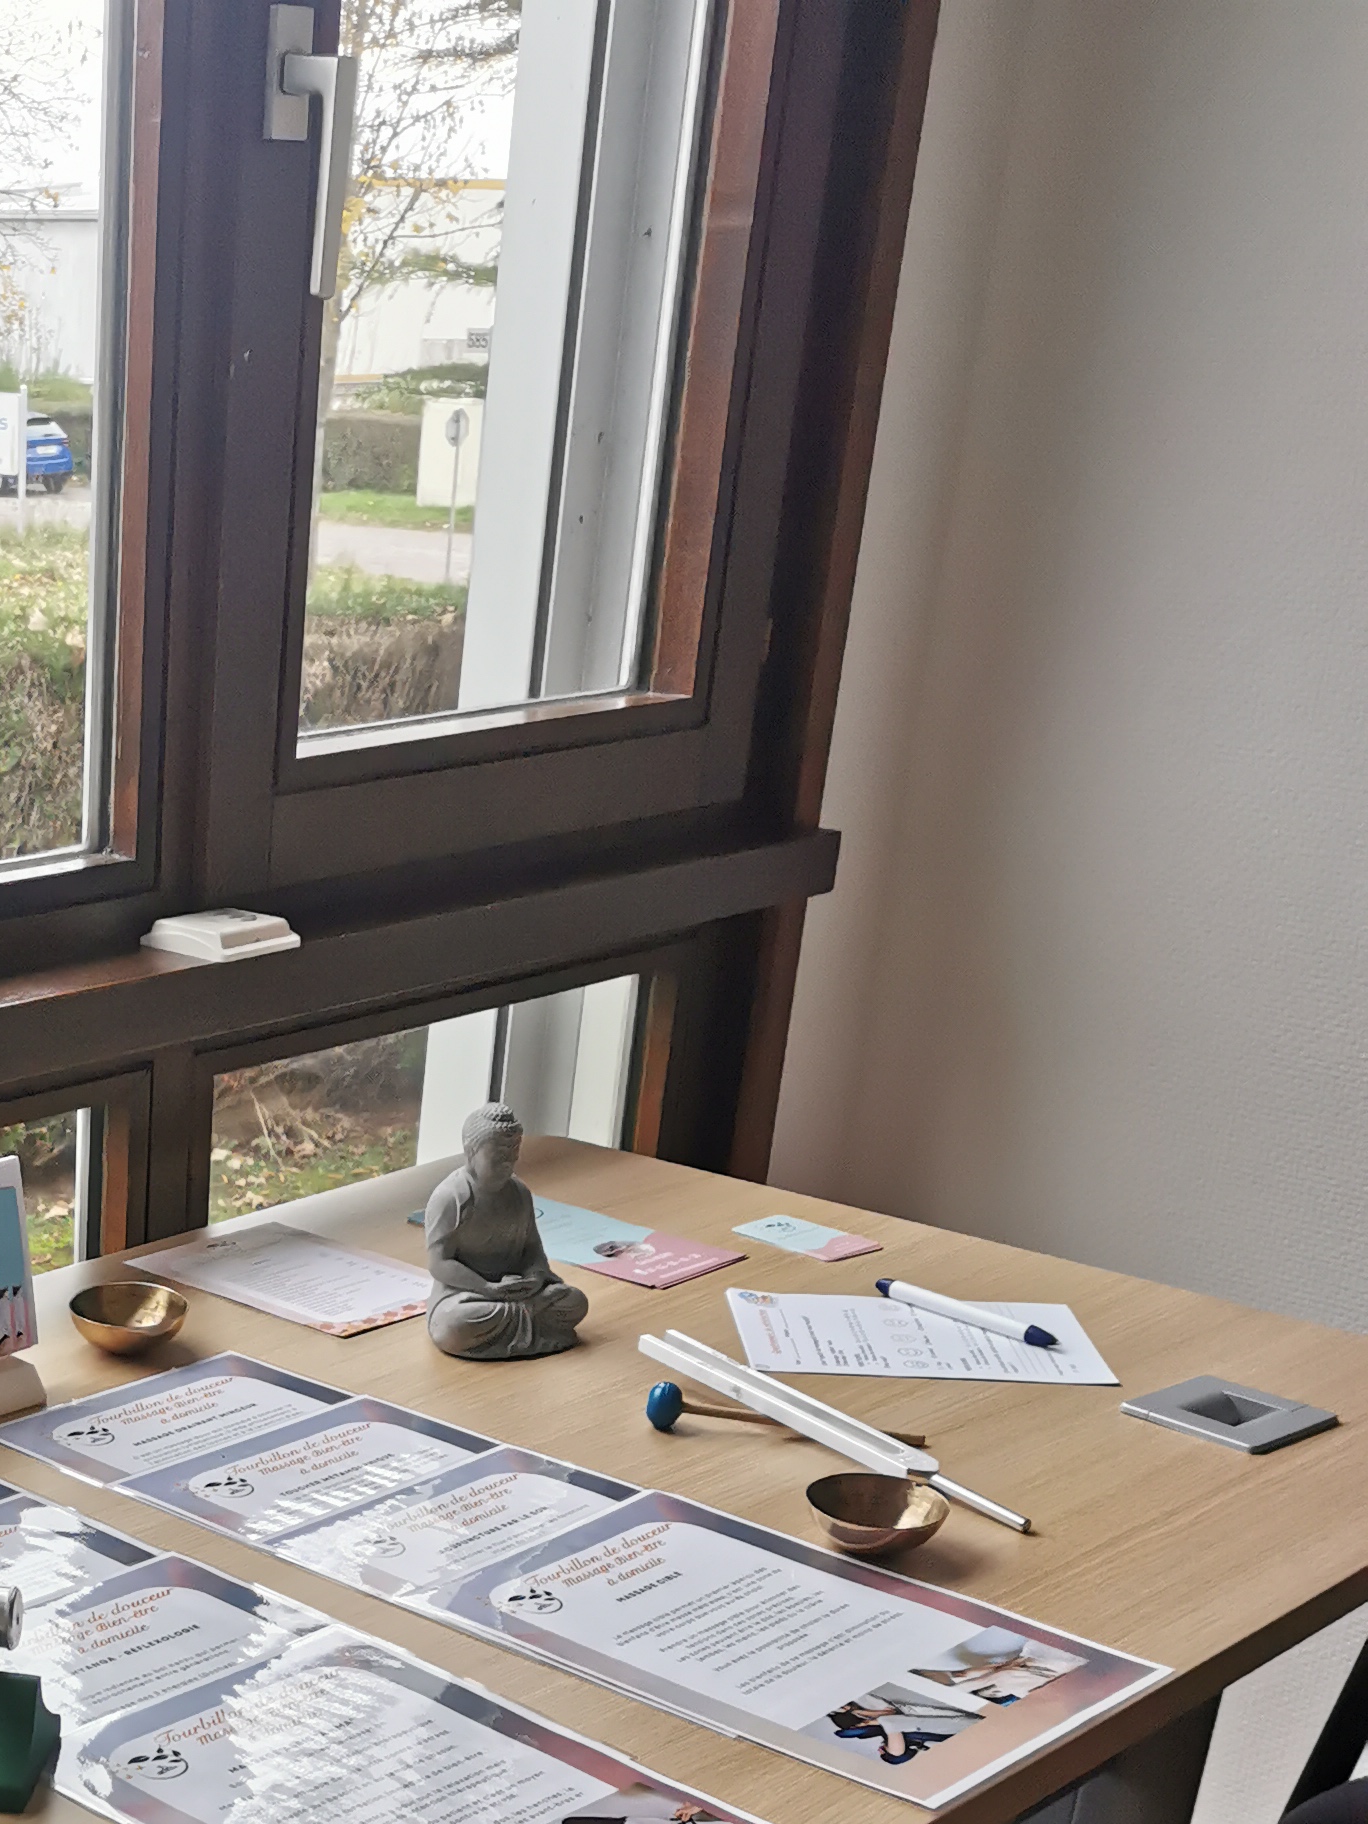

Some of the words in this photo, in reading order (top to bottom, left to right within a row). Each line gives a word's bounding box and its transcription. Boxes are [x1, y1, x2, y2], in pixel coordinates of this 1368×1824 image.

[91, 1402, 157, 1425] Tourbillon
[166, 1393, 179, 1402] de
[185, 1374, 232, 1396] douceur
[172, 1402, 215, 1420] domicile
[124, 1406, 171, 1424] Massage
[133, 1431, 174, 1446] MASSAGE
[175, 1416, 217, 1433] DRAINANT
[219, 1403, 256, 1418] MINCEUR
[228, 1450, 294, 1475] Tourbillon
[303, 1441, 316, 1451] de
[322, 1420, 370, 1444] douceur
[262, 1455, 308, 1474] Massage
[312, 1436, 360, 1457] Bien-être
[311, 1451, 358, 1471] domicile
[279, 1480, 321, 1496] TOUCHER
[389, 1503, 446, 1529] ourbillon
[451, 1494, 465, 1505] de
[470, 1471, 517, 1497] douceur
[460, 1489, 508, 1512] Bien-être
[462, 1505, 506, 1526] domicile
[500, 1519, 519, 1527] PAR
[527, 1556, 601, 1586] Tourbillon
[603, 1545, 618, 1558] de
[621, 1518, 670, 1549] douceur
[564, 1563, 613, 1586] Massage
[614, 1540, 664, 1566] Bien-être
[618, 1558, 664, 1580] domicile
[88, 1611, 102, 1624] de
[112, 1584, 170, 1615] douceur
[616, 1583, 658, 1602] MASSAGE
[96, 1606, 156, 1632] Bien-être
[94, 1624, 146, 1648] domicile
[124, 1624, 200, 1656] RÉFLEXOLOGIE
